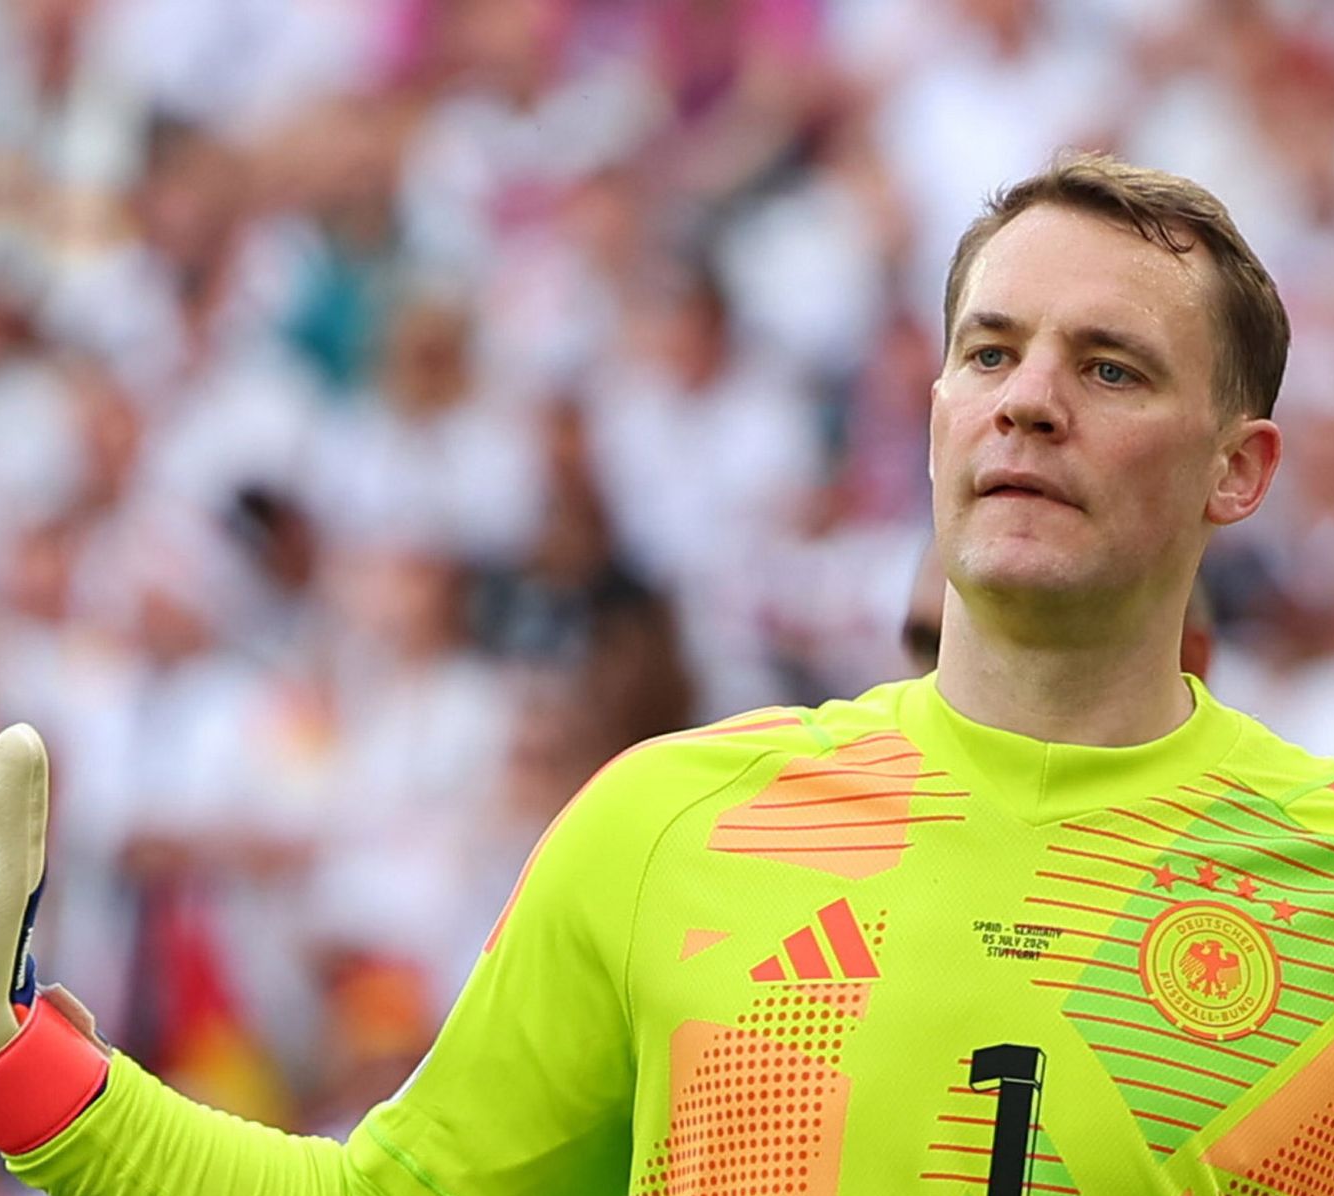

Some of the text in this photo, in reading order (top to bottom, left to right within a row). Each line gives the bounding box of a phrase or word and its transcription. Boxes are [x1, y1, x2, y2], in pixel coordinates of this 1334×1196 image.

[982, 933, 1050, 950] 05 JULY 2024
[1176, 917, 1256, 954] DEUTSCHER
[1159, 971, 1255, 1022] FUSSBALL-BUND
